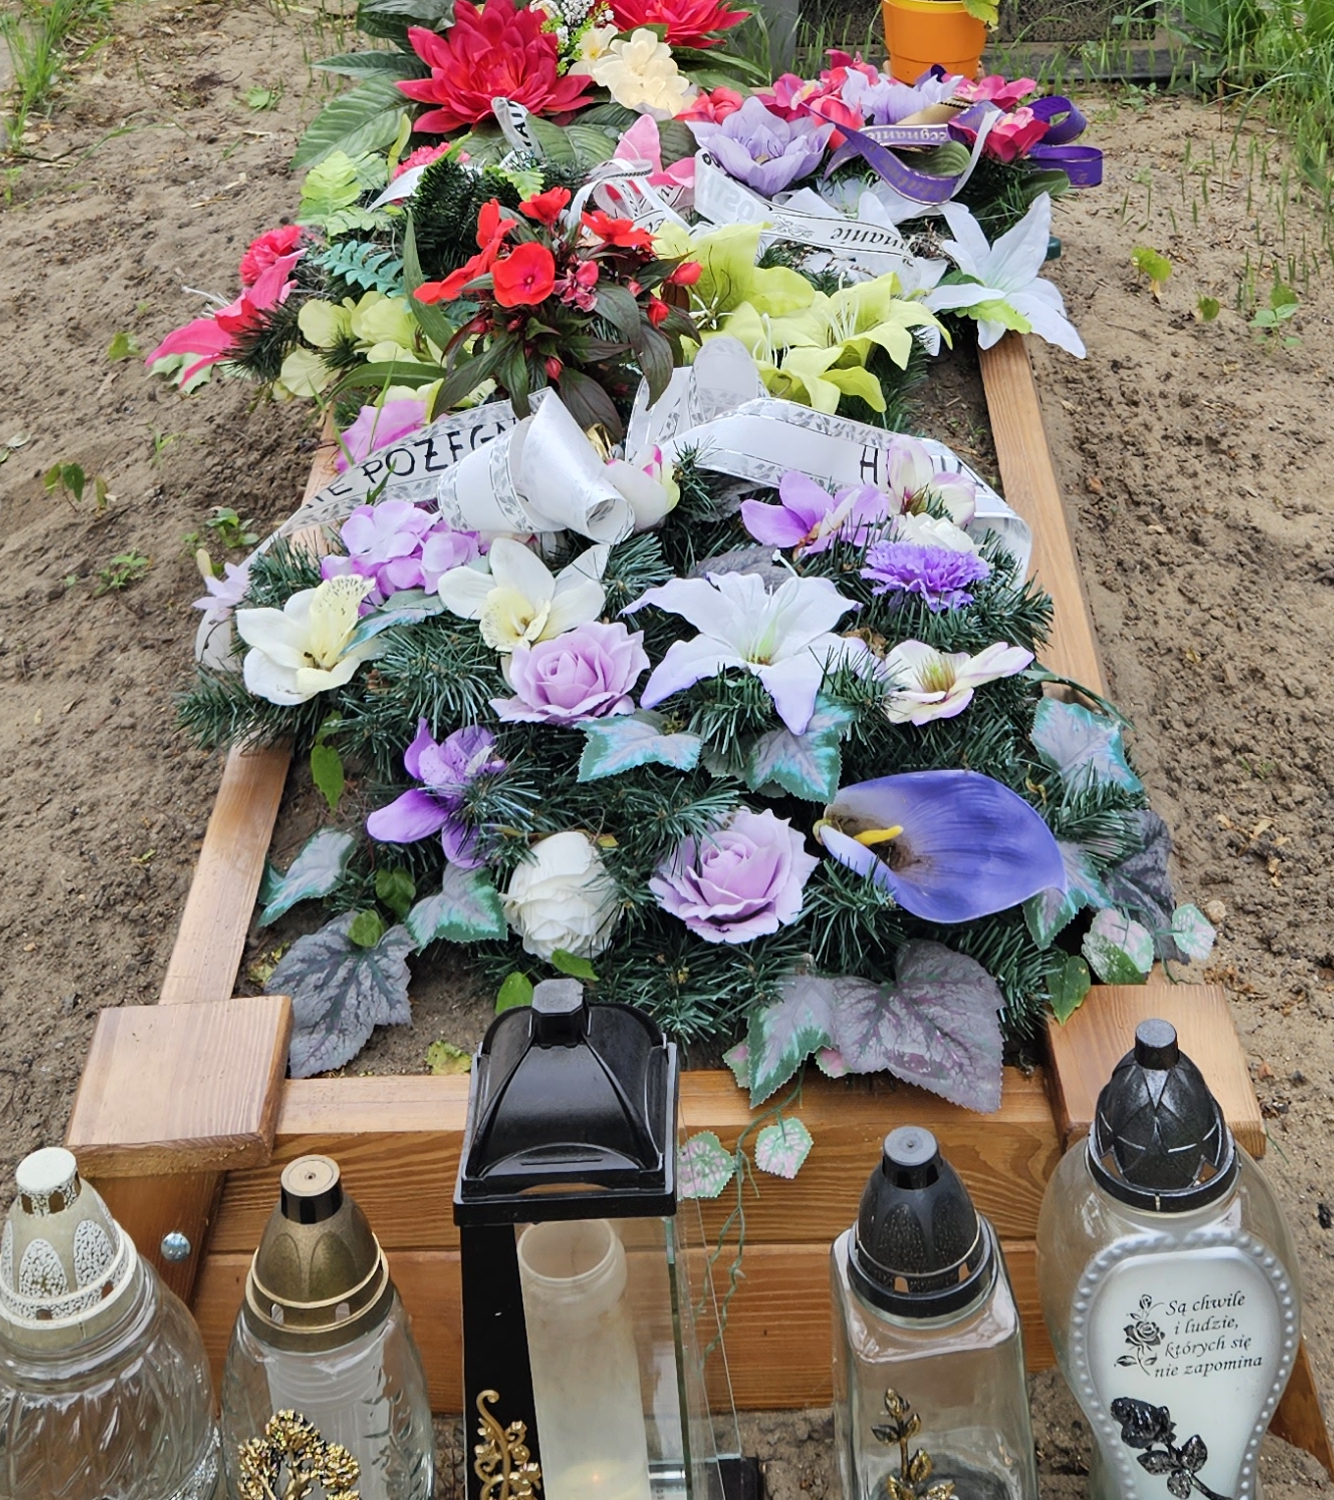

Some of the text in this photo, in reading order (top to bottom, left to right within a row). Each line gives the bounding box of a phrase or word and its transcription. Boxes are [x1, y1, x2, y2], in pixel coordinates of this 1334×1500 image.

[1165, 1290, 1246, 1317] Są chwile
[1174, 1315, 1239, 1335] i ludzie,
[1164, 1335, 1252, 1359] których się
[1154, 1355, 1263, 1378] nie zapomina
